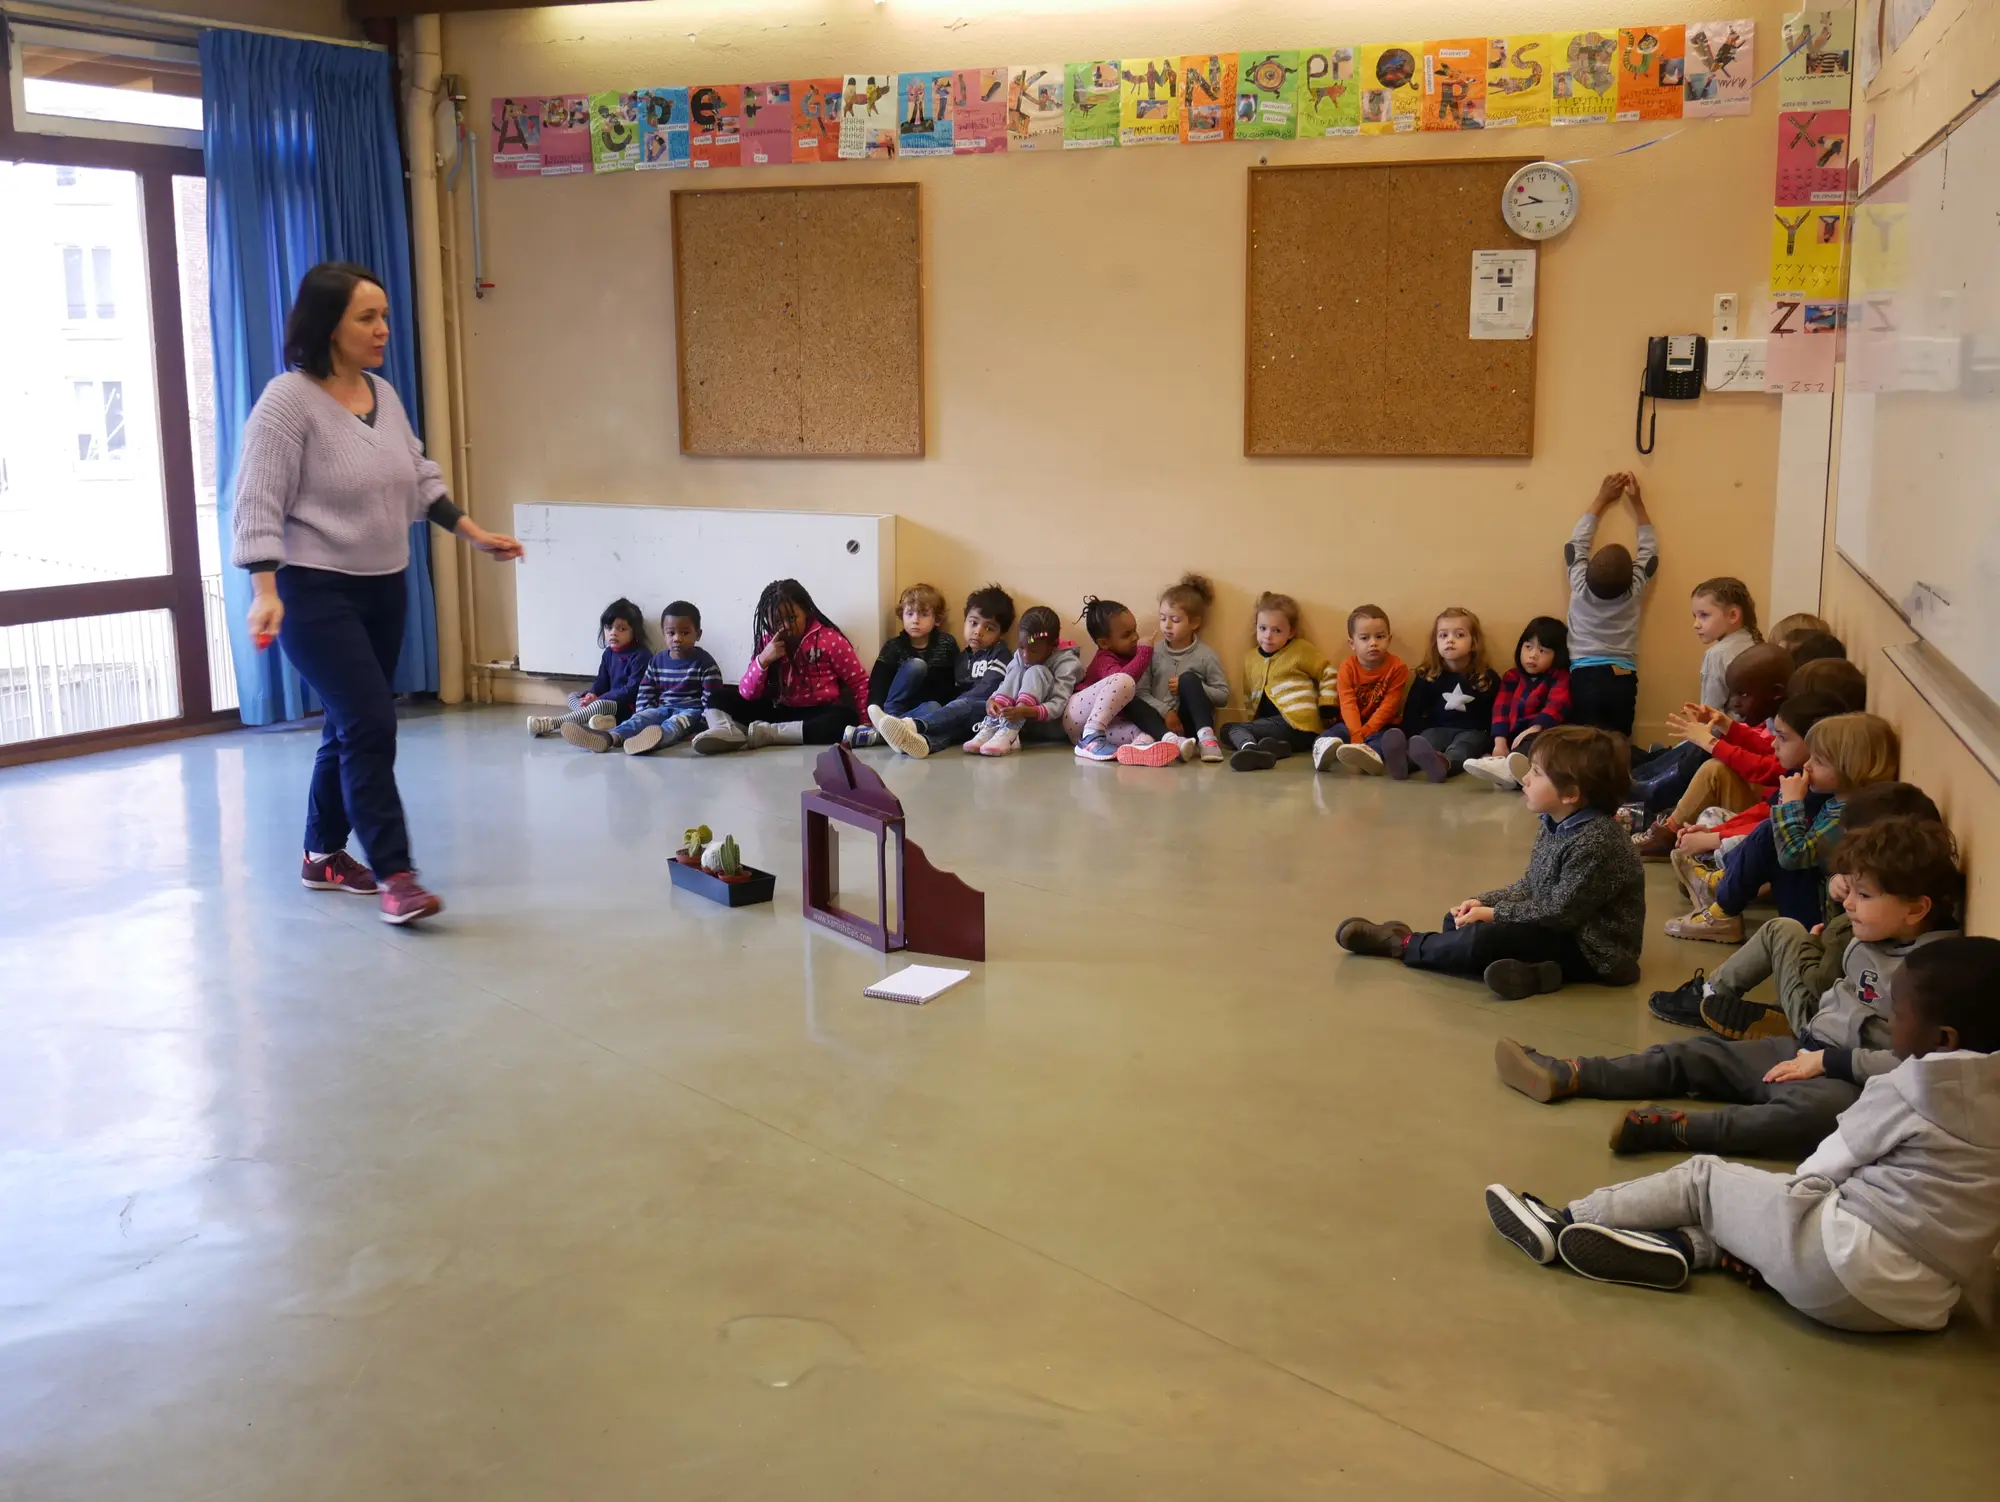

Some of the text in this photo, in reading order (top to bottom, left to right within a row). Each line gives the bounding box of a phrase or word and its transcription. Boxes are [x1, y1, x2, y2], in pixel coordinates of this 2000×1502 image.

[1788, 113, 1817, 149] X
[1774, 208, 1812, 256] Y
[1771, 301, 1800, 334] Z
[1857, 968, 1880, 1005] S
